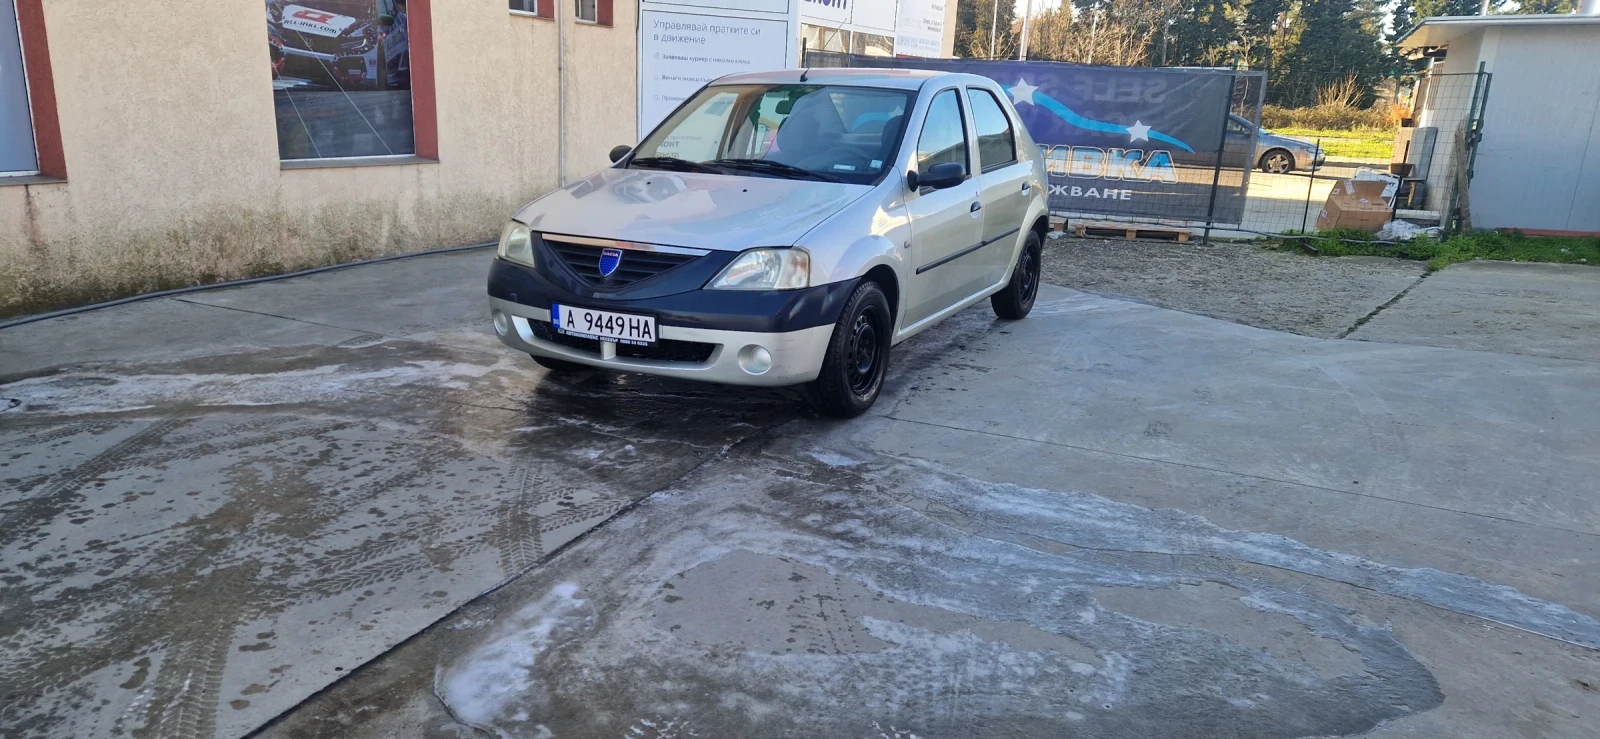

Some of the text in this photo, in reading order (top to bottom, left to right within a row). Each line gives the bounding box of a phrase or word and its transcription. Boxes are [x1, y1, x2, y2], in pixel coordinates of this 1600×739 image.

[653, 19, 761, 36] Управлявай пратките си
[661, 35, 706, 45] движение
[566, 309, 652, 340] A 9449 HA
